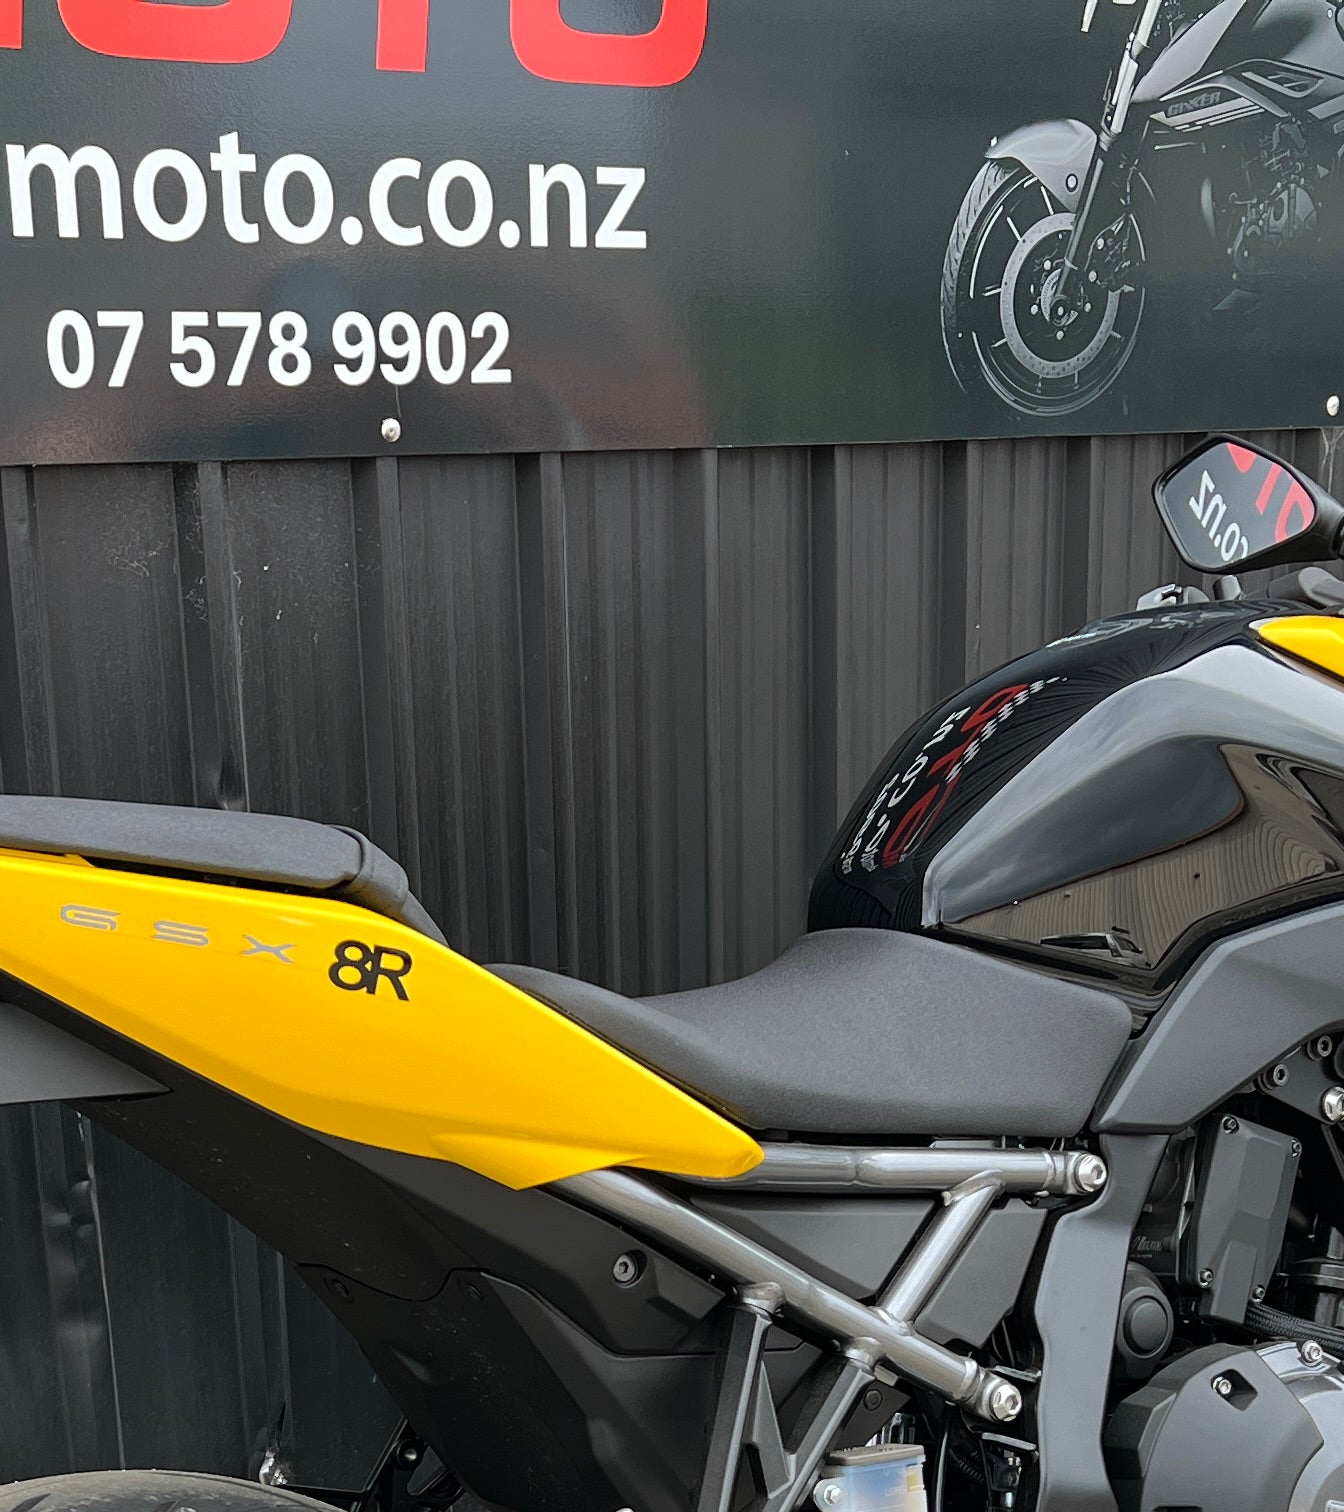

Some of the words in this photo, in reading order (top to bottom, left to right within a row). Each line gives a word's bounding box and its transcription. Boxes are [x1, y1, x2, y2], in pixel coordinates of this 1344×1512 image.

[46, 310, 145, 389] 07
[168, 310, 313, 388] 578
[332, 309, 513, 385] 9902
[328, 939, 413, 1002] 8R
